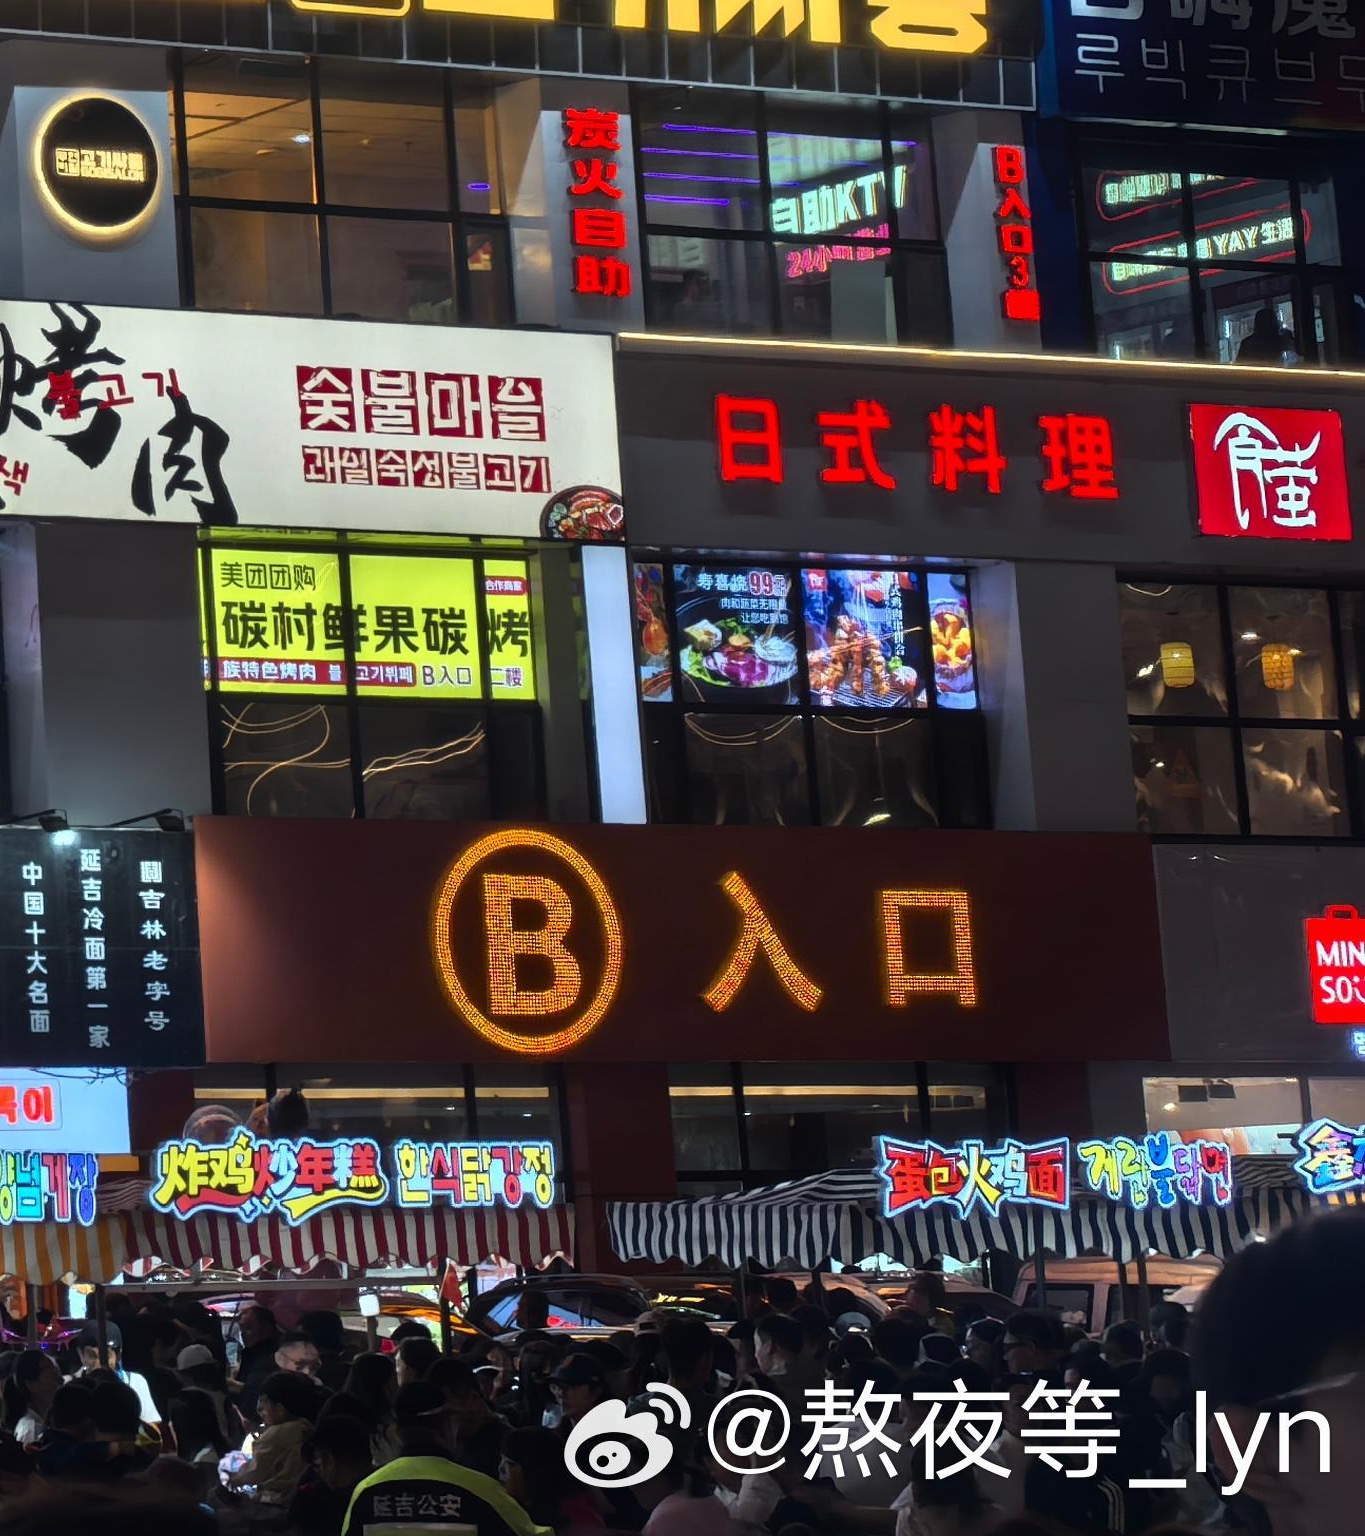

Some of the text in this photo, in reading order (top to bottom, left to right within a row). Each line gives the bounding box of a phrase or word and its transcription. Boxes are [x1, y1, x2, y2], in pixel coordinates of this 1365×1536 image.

[564, 106, 631, 299] 炭火自助
[45, 368, 181, 420] 불고기
[303, 445, 553, 495] 과일숙성불고기
[715, 393, 1120, 501] 日式料理
[221, 562, 316, 591] 美团团购
[21, 860, 51, 1034] 中国十大名面
[79, 848, 112, 1050] 延吉冷面第一家
[481, 869, 983, 1017] B 入口
[154, 1139, 379, 1206] 炸鸡炒年糕
[399, 1143, 554, 1206] 한식닭강정
[881, 1140, 1068, 1214] 蛋包火鸡面
[373, 1492, 462, 1517] 延吉公安
